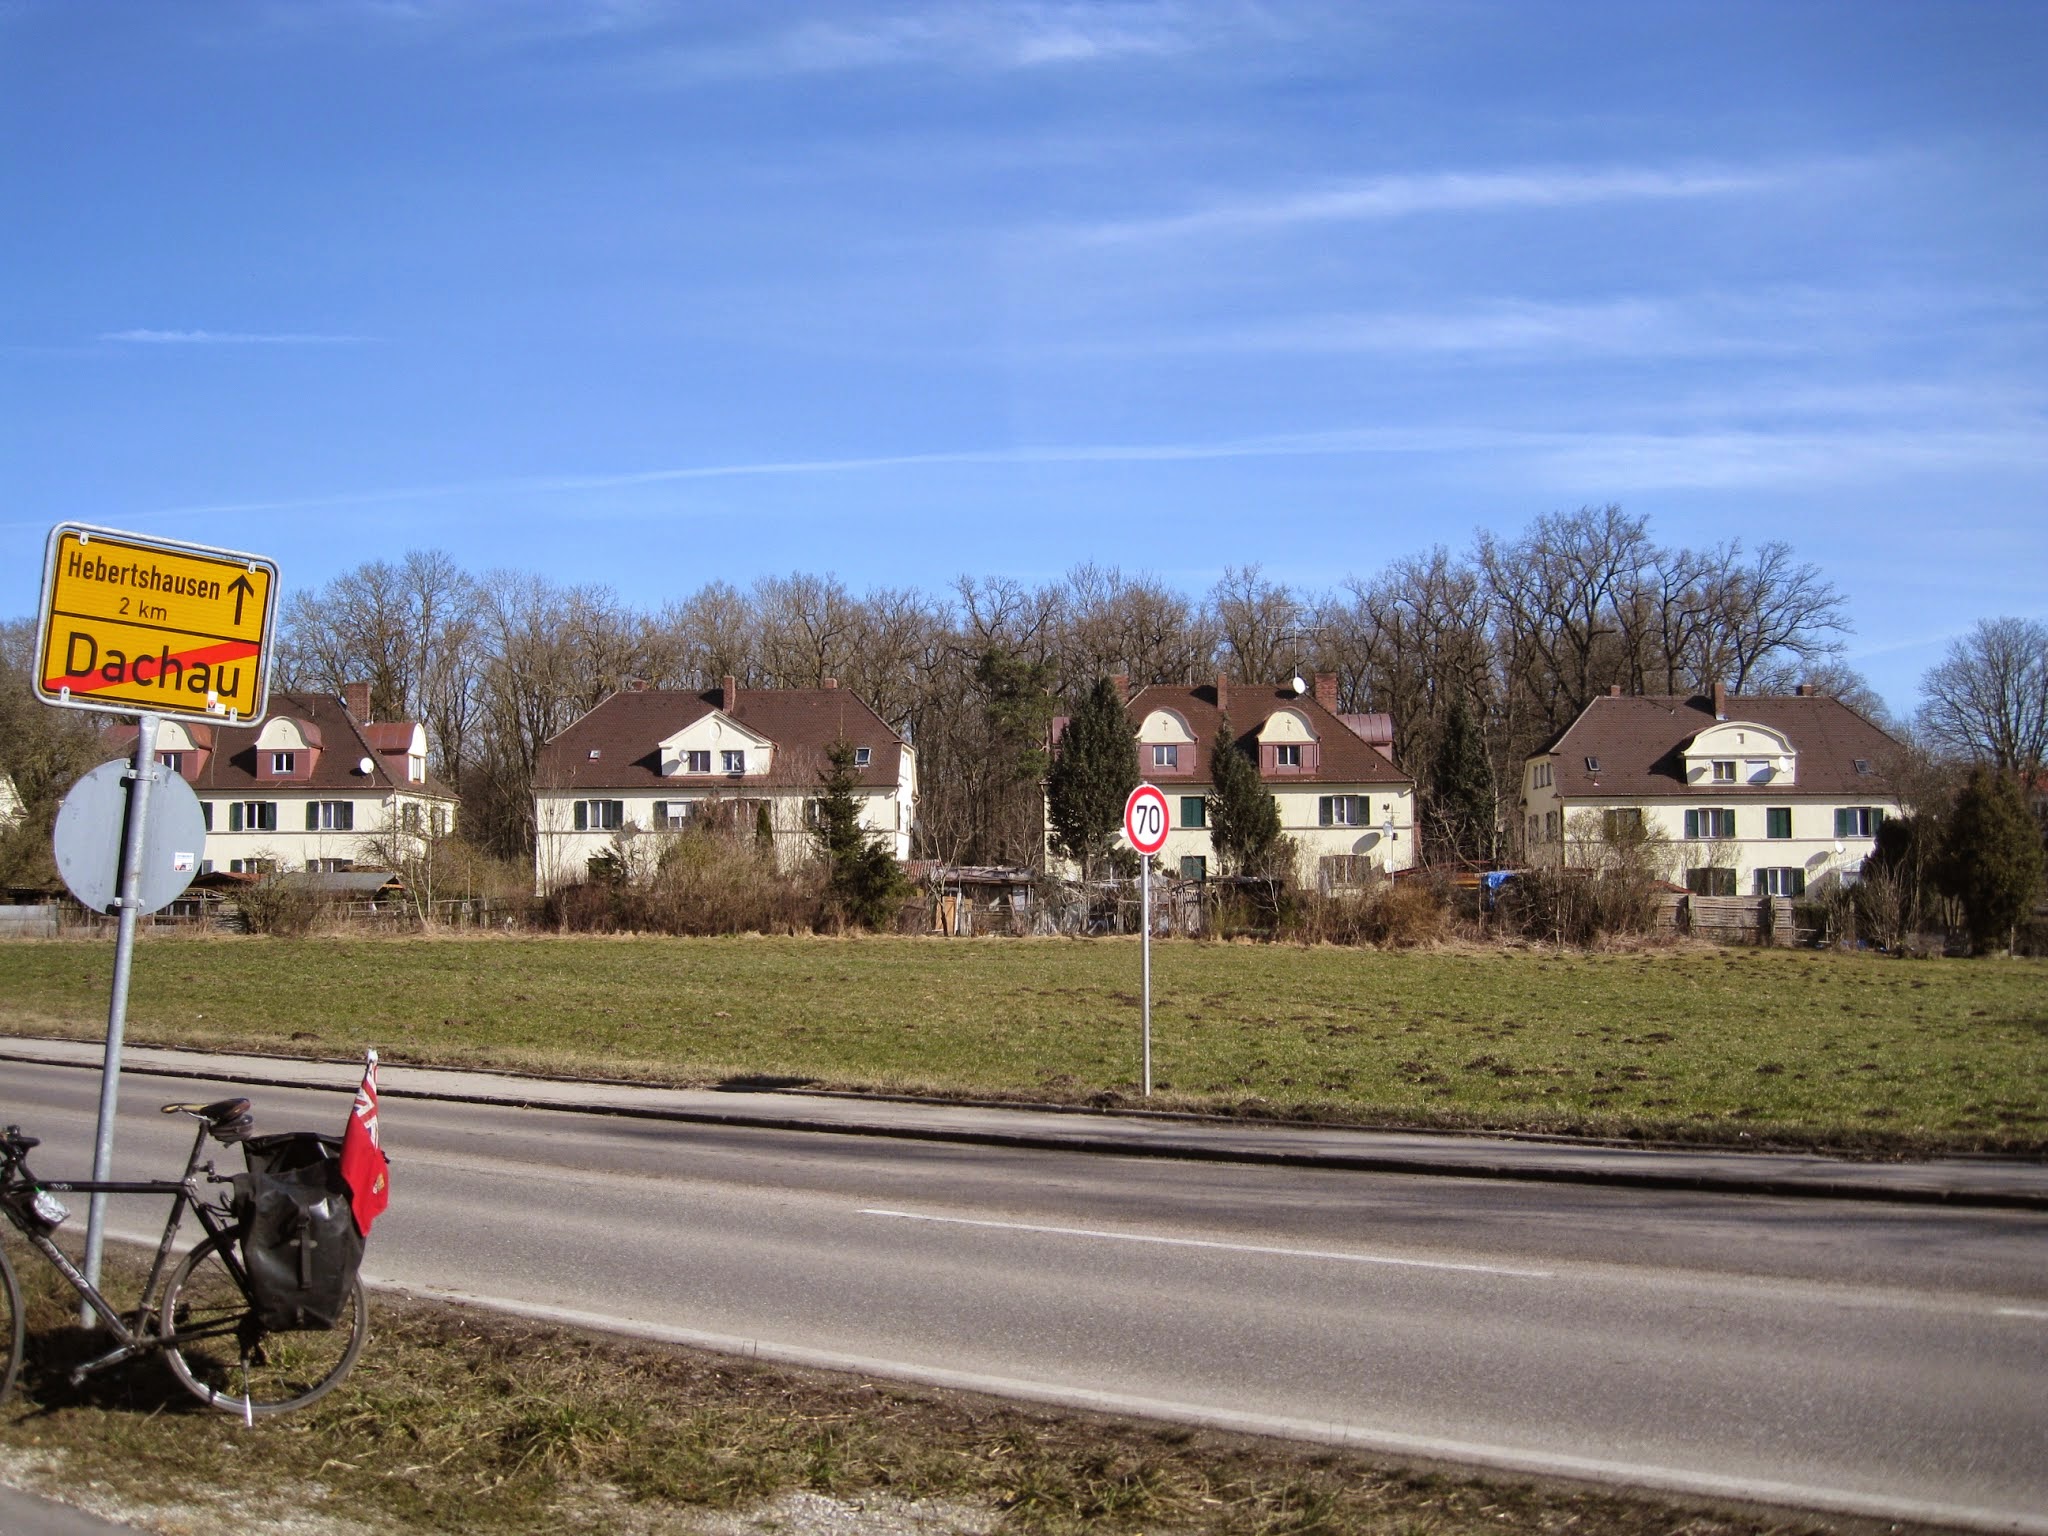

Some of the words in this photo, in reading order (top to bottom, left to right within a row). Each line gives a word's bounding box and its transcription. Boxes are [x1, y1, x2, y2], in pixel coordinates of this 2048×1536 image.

[67, 551, 221, 600] Hebertshausen
[118, 596, 131, 615] 2
[138, 599, 168, 621] km
[65, 631, 240, 698] Dachau
[1136, 805, 1161, 835] 70
